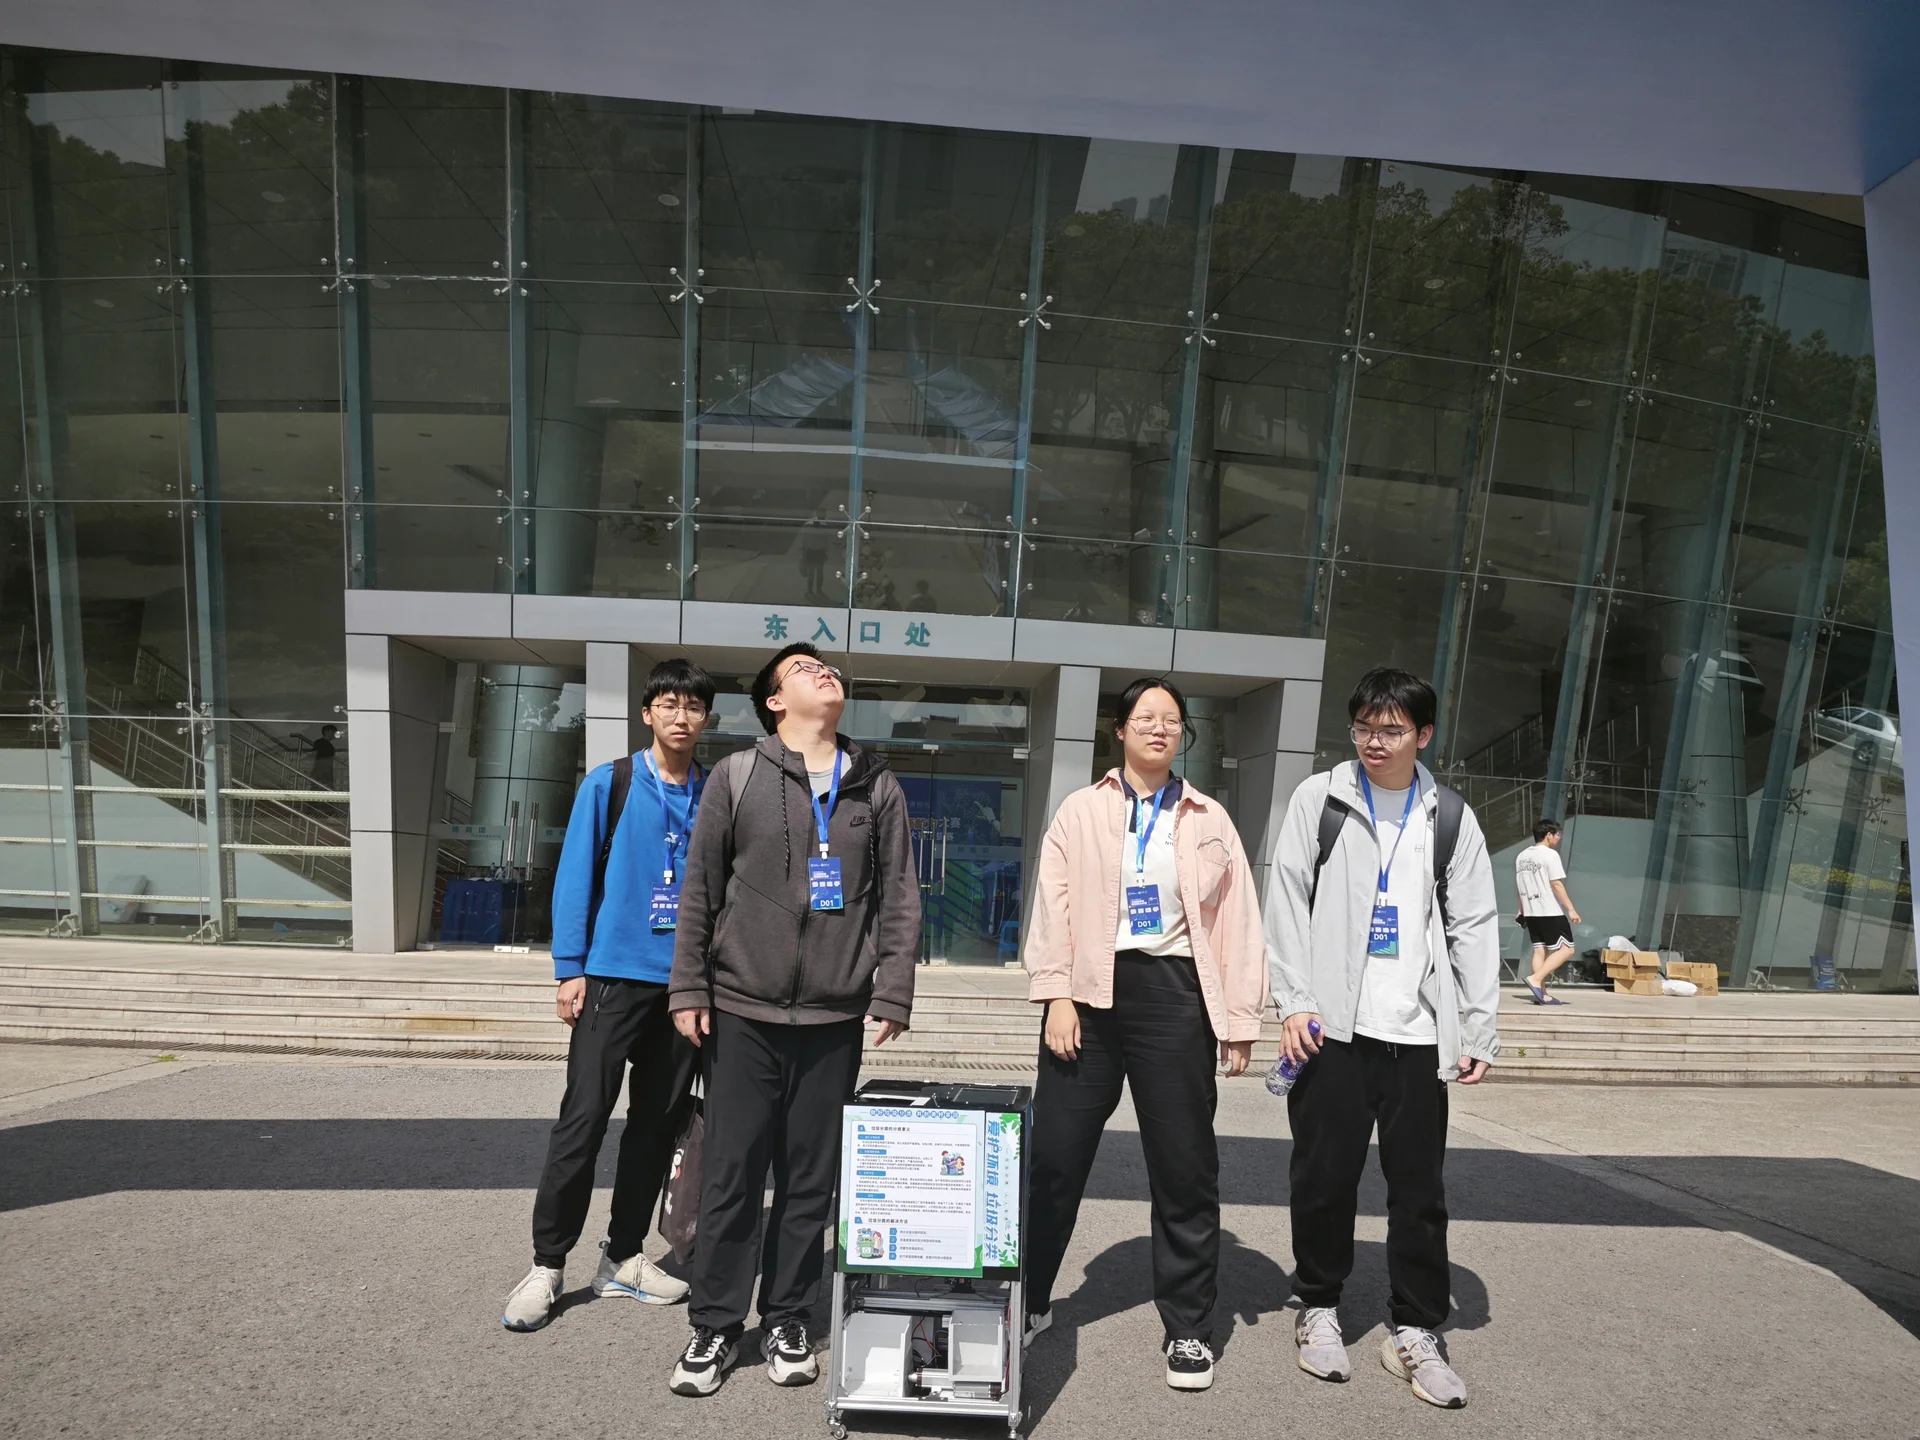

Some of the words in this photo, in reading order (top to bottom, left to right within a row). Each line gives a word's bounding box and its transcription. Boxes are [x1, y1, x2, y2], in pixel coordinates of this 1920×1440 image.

[764, 614, 931, 647] 东入口处
[1137, 920, 1152, 928] D01
[1373, 933, 1388, 941] D01
[986, 1120, 1000, 1187] 爱护环境
[983, 1191, 1001, 1260] 垃圾分类
